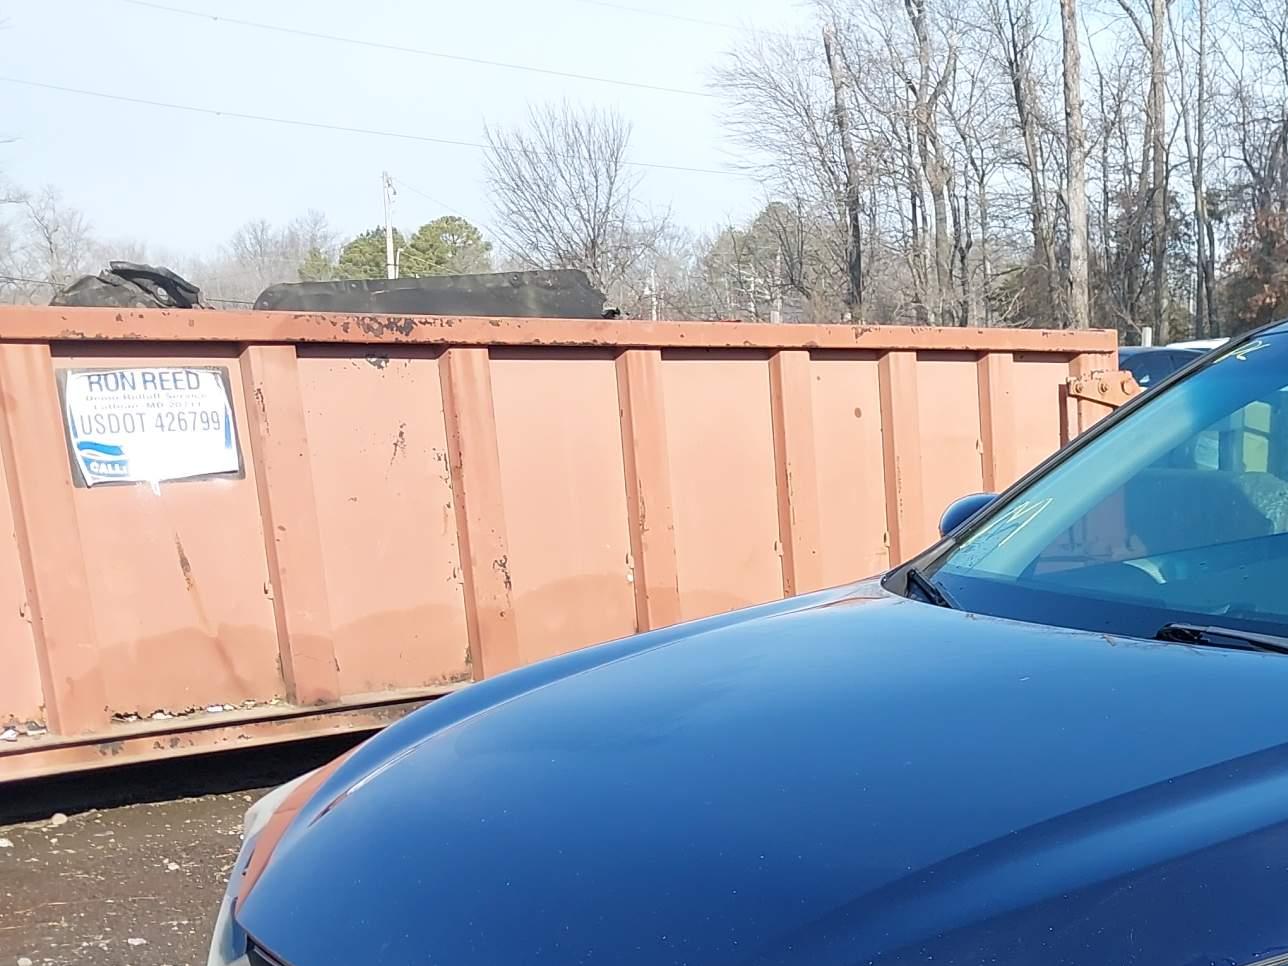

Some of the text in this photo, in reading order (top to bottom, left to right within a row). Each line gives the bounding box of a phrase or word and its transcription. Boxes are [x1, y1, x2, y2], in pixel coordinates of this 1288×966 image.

[87, 370, 201, 392] RON REED
[80, 410, 221, 435] USDOT 426799
